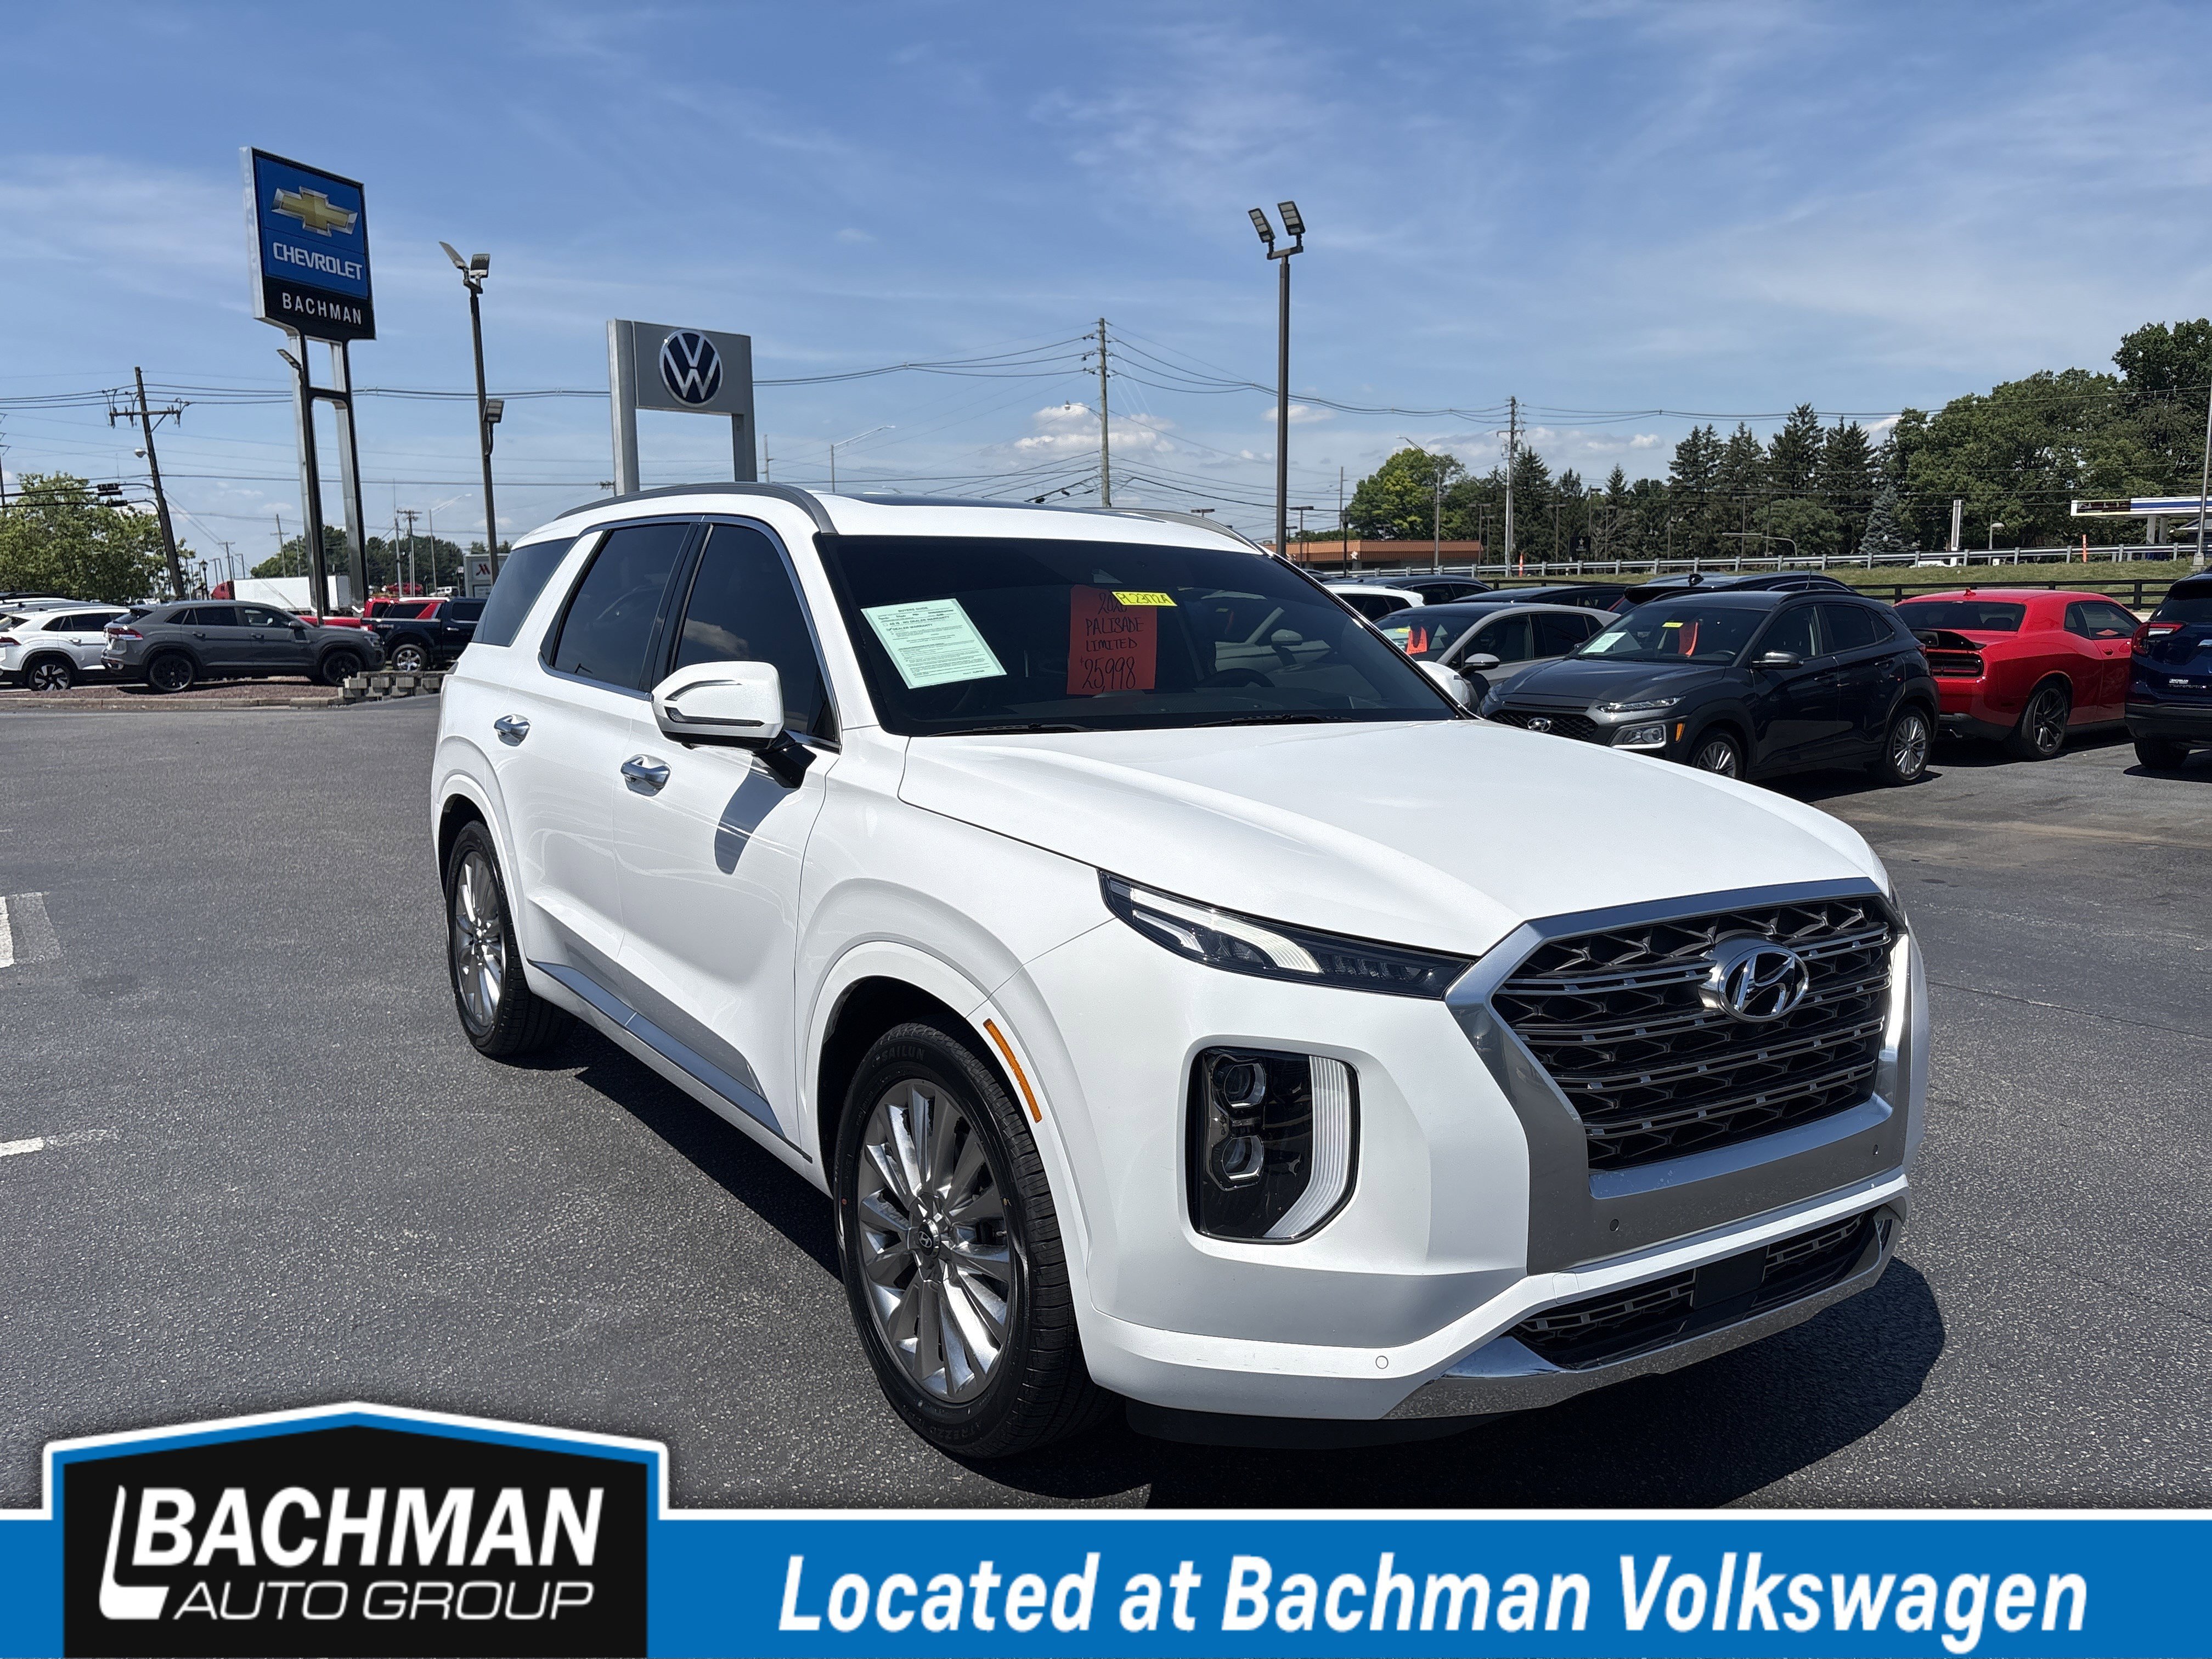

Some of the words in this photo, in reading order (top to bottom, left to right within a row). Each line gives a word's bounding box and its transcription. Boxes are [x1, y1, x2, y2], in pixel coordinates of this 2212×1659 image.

[273, 241, 363, 281] CHEVROLET
[282, 292, 362, 325] BACHMAN
[1086, 617, 1144, 636] PALISADE
[1086, 637, 1137, 652] LIMITED
[881, 1045, 926, 1061] SAILUN
